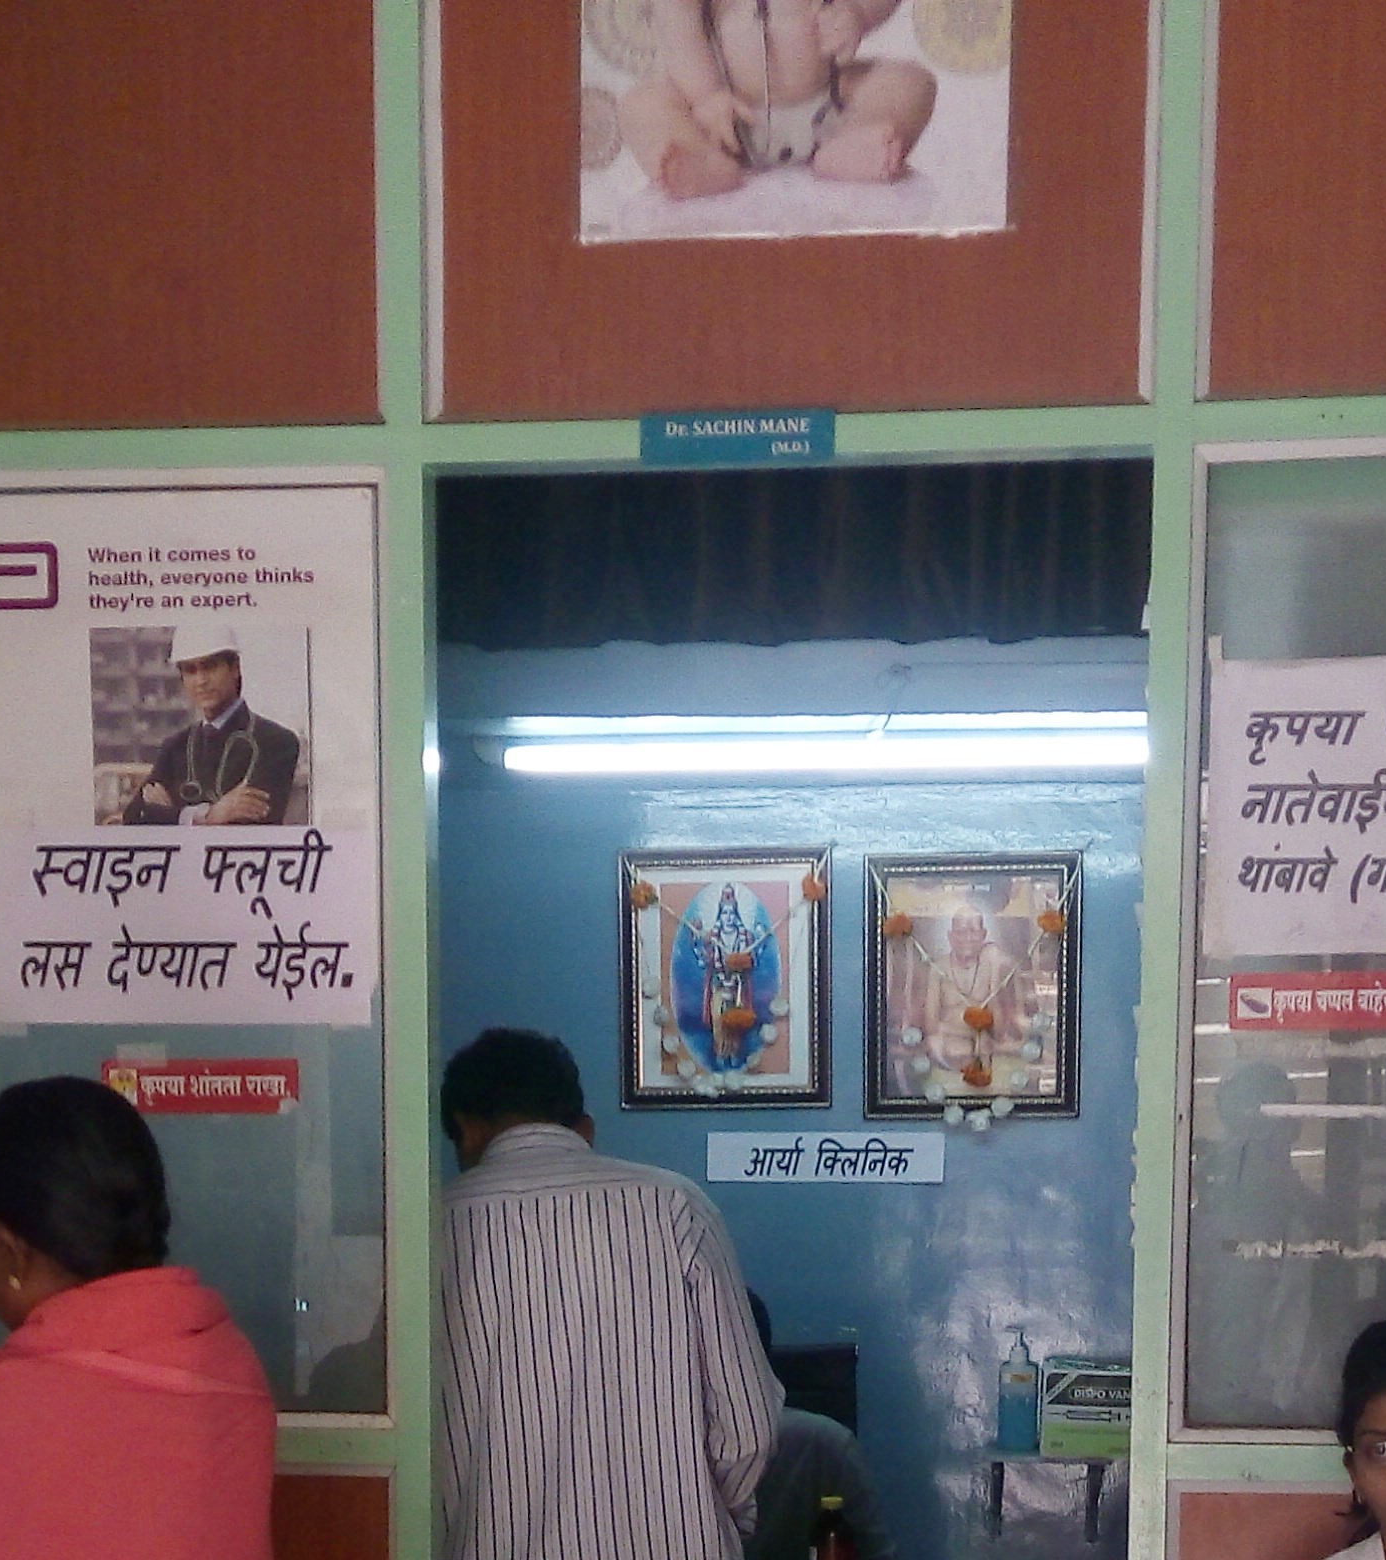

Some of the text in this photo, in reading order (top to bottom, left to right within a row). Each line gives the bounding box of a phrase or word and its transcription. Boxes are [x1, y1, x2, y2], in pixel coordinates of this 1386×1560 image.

[666, 416, 811, 437] Dr. SACHIN MANE
[88, 547, 256, 563] When it comes to
[88, 567, 314, 588] health, everyone thinks
[89, 592, 257, 612] they're an expert.
[1244, 708, 1366, 766] कृपया
[32, 828, 333, 920] स्वाइन फ्लूची
[1238, 843, 1338, 894] थांबावे
[20, 921, 354, 1001] लस देण्यात येईल.
[1273, 989, 1313, 1024] कृपया
[139, 1074, 185, 1107] कृपया
[744, 1136, 915, 1178] आर्या क्लिनिक
